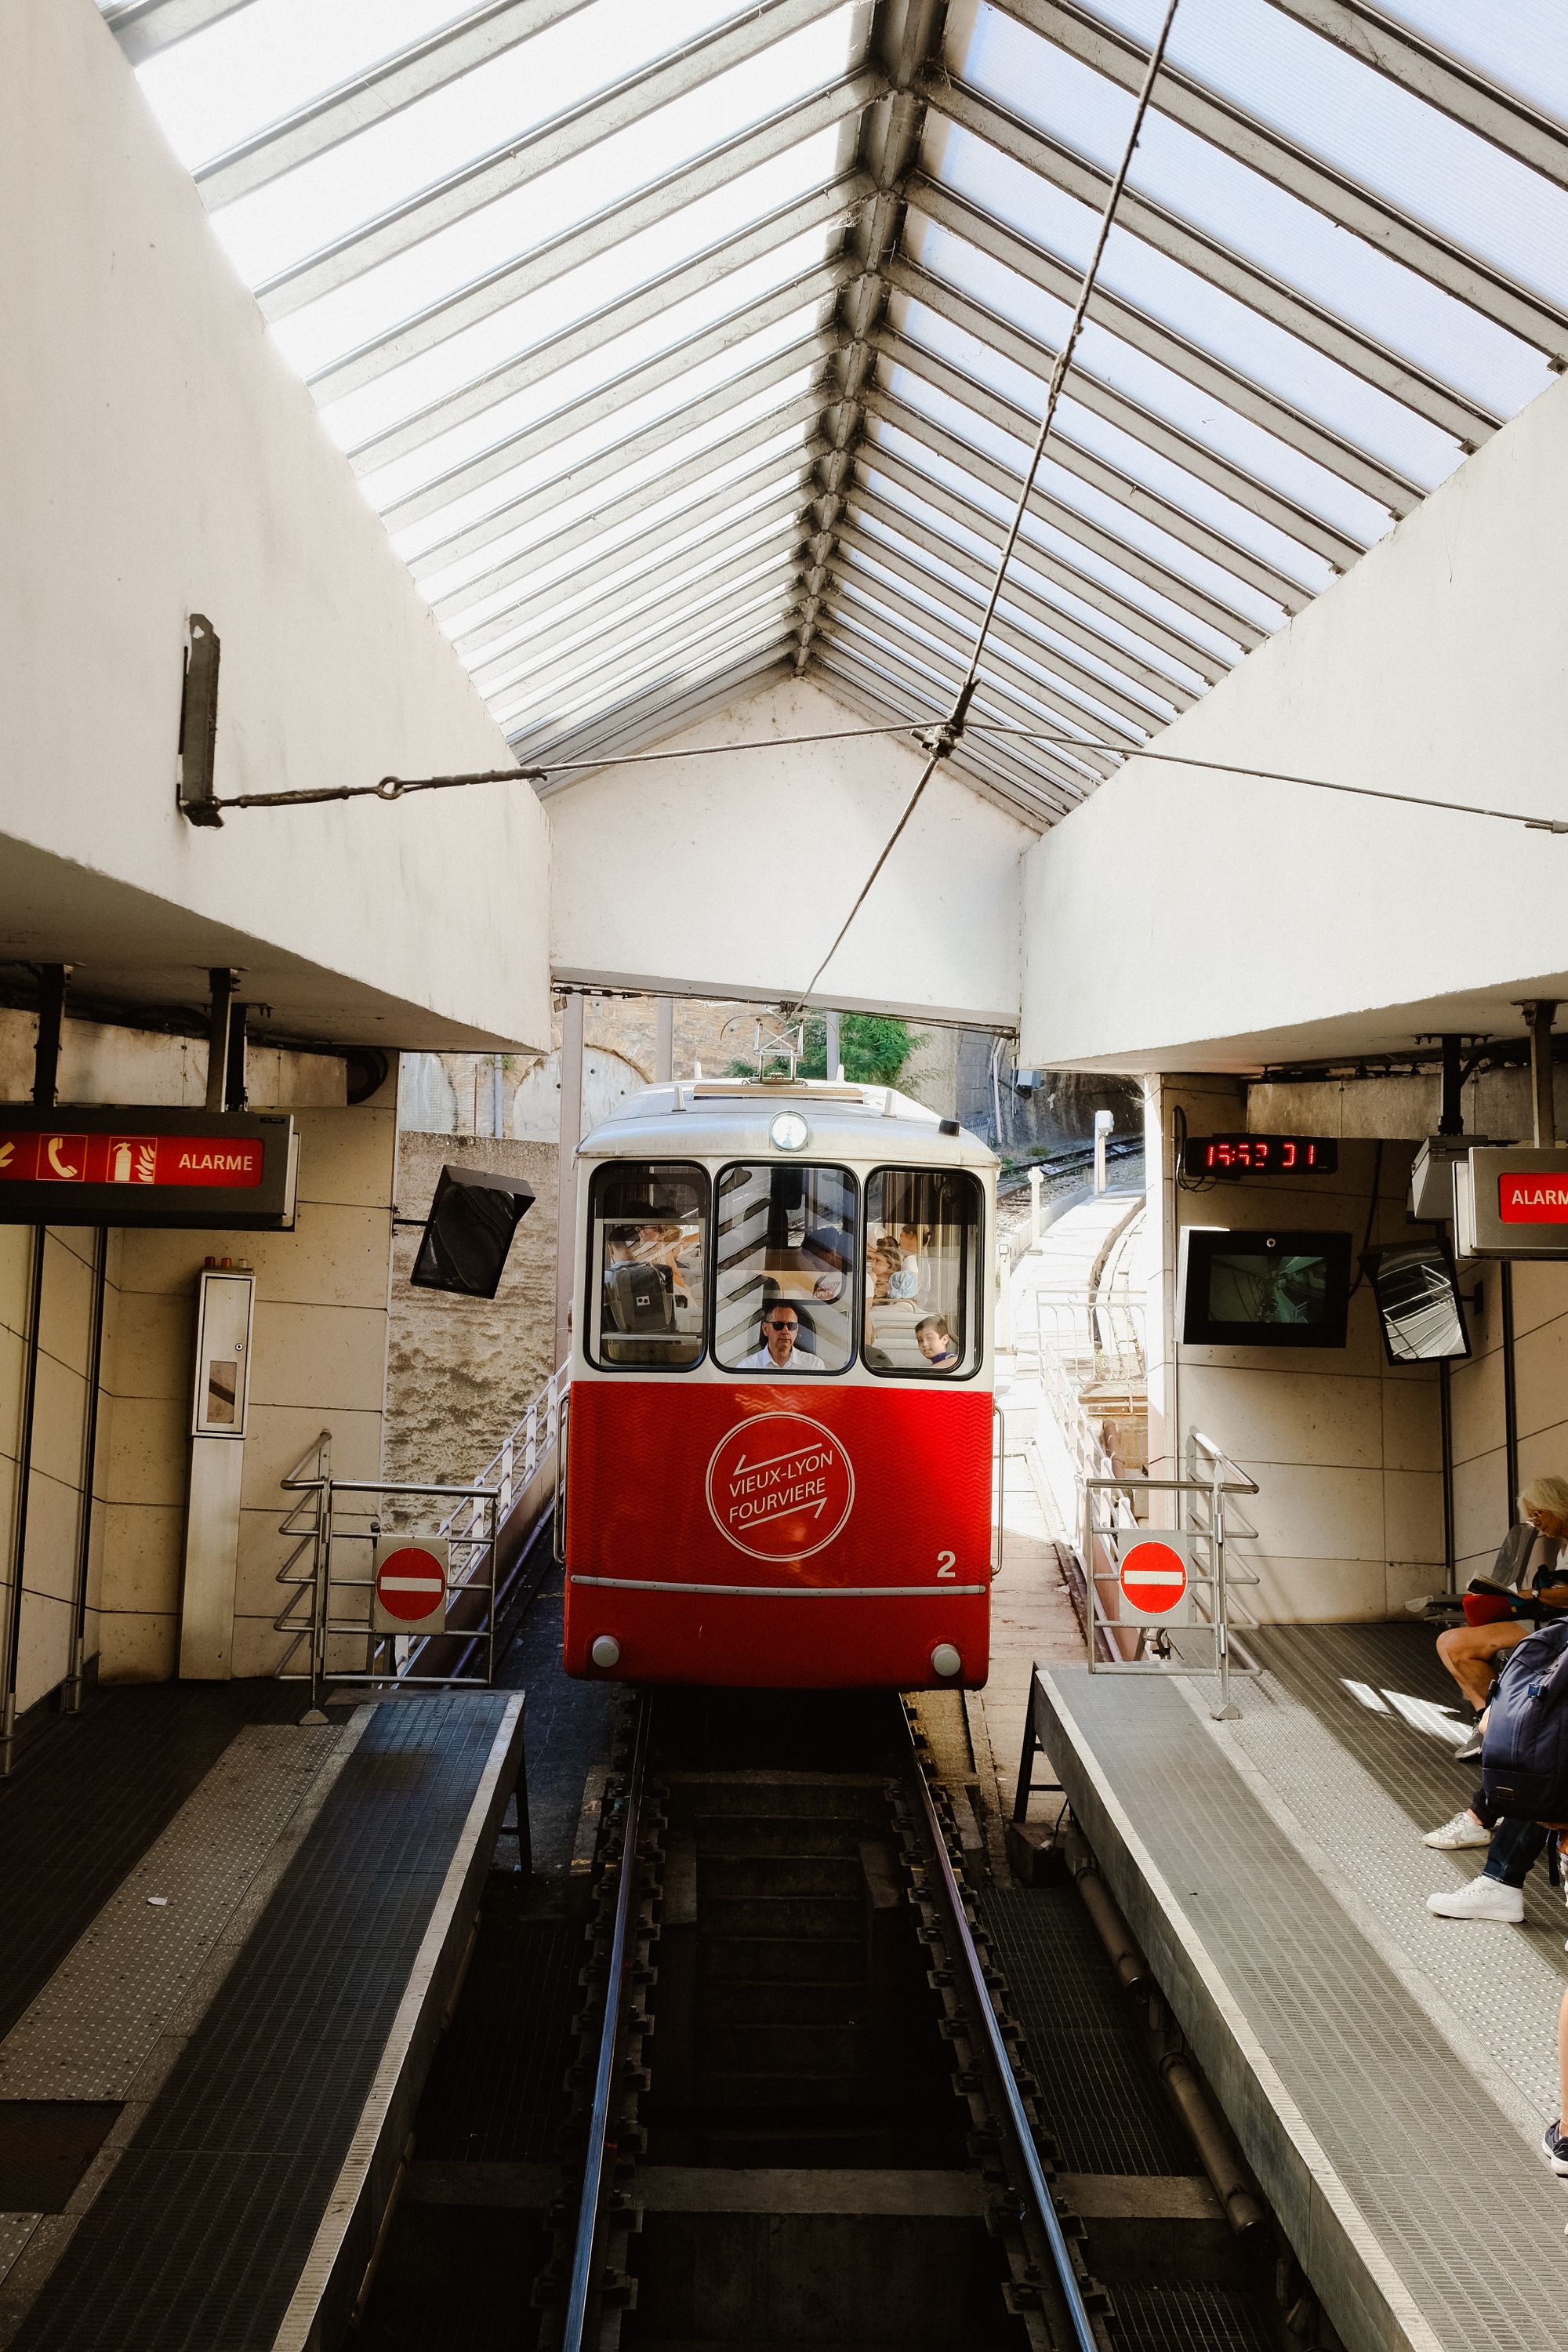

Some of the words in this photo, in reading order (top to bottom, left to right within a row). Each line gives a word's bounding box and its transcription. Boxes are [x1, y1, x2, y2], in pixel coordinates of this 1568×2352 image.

[178, 1153, 253, 1171] ALARME
[729, 1450, 833, 1497] VIEUX-LYON
[729, 1477, 826, 1523] FOURVIERE
[937, 1550, 956, 1577] 2
